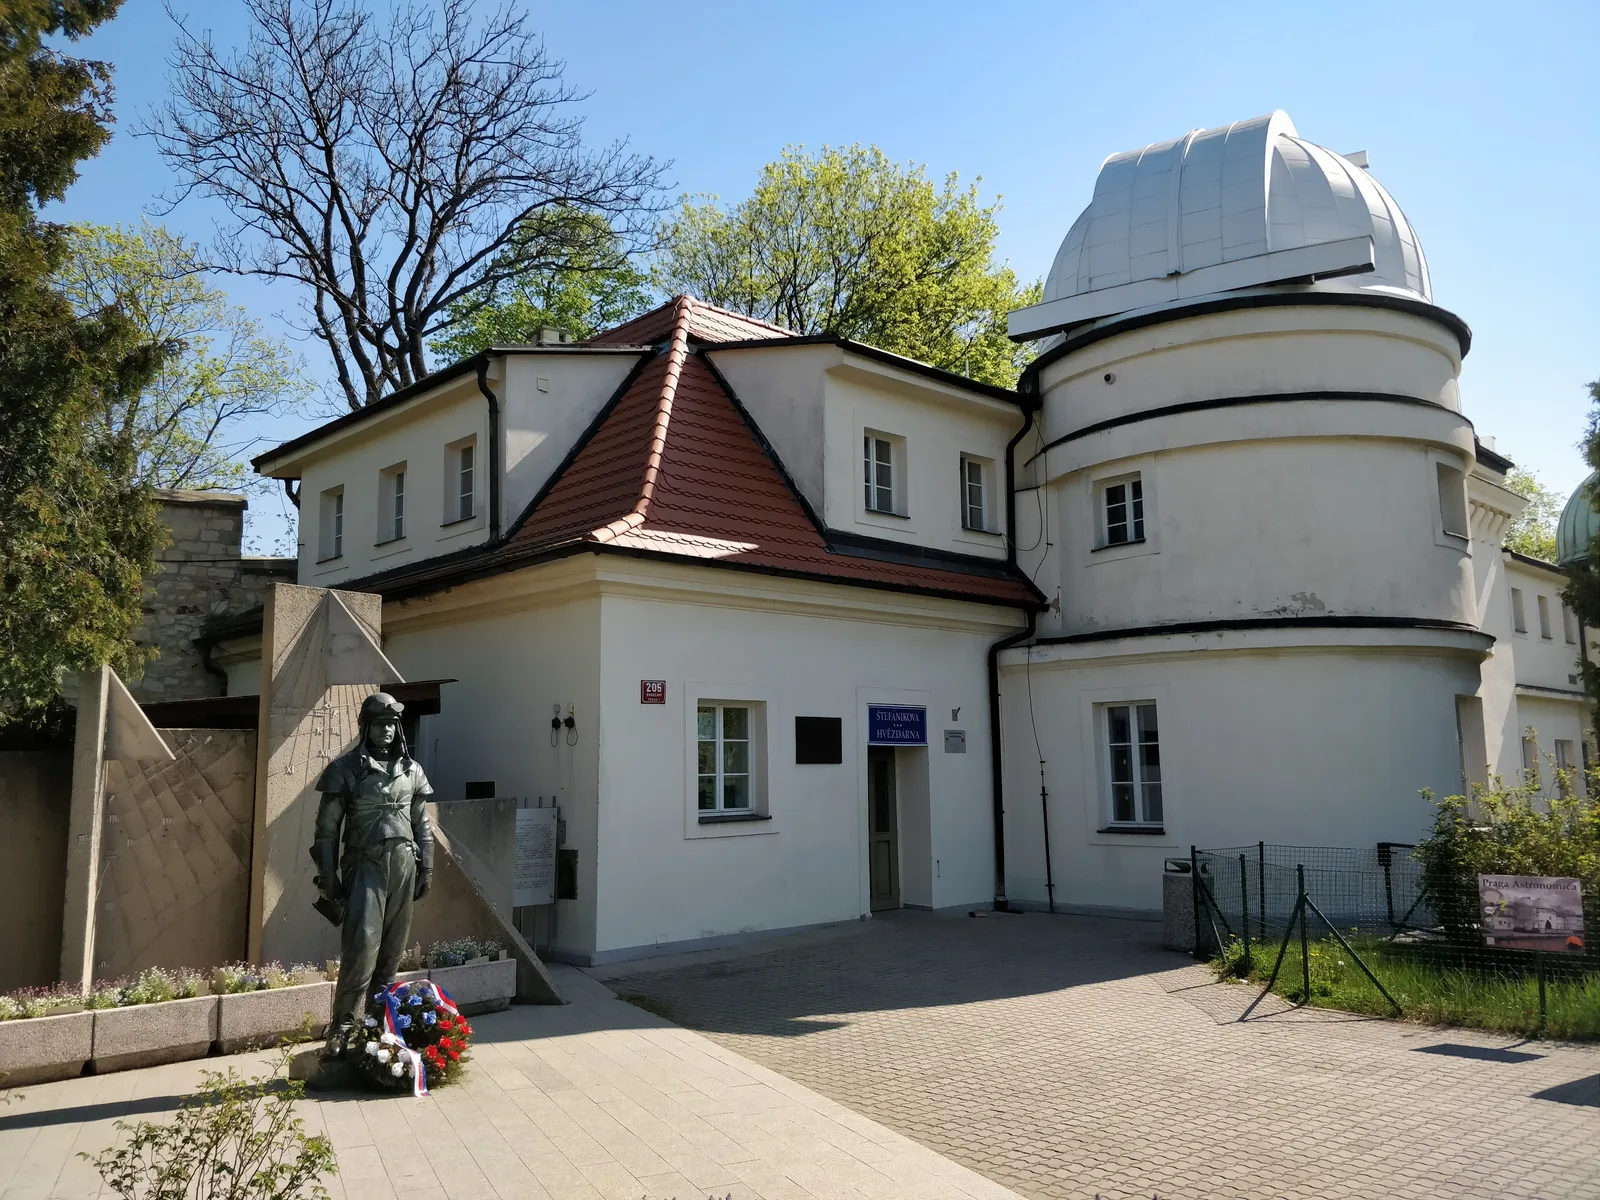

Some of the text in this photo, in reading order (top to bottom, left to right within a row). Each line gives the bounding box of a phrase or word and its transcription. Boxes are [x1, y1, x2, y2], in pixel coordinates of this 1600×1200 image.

[646, 683, 662, 692] 205
[876, 710, 920, 722] ŠTEFÁNIKOVA
[876, 727, 920, 739] HVĚZDÁRNA
[1482, 878, 1577, 891] Praga Astronomica
